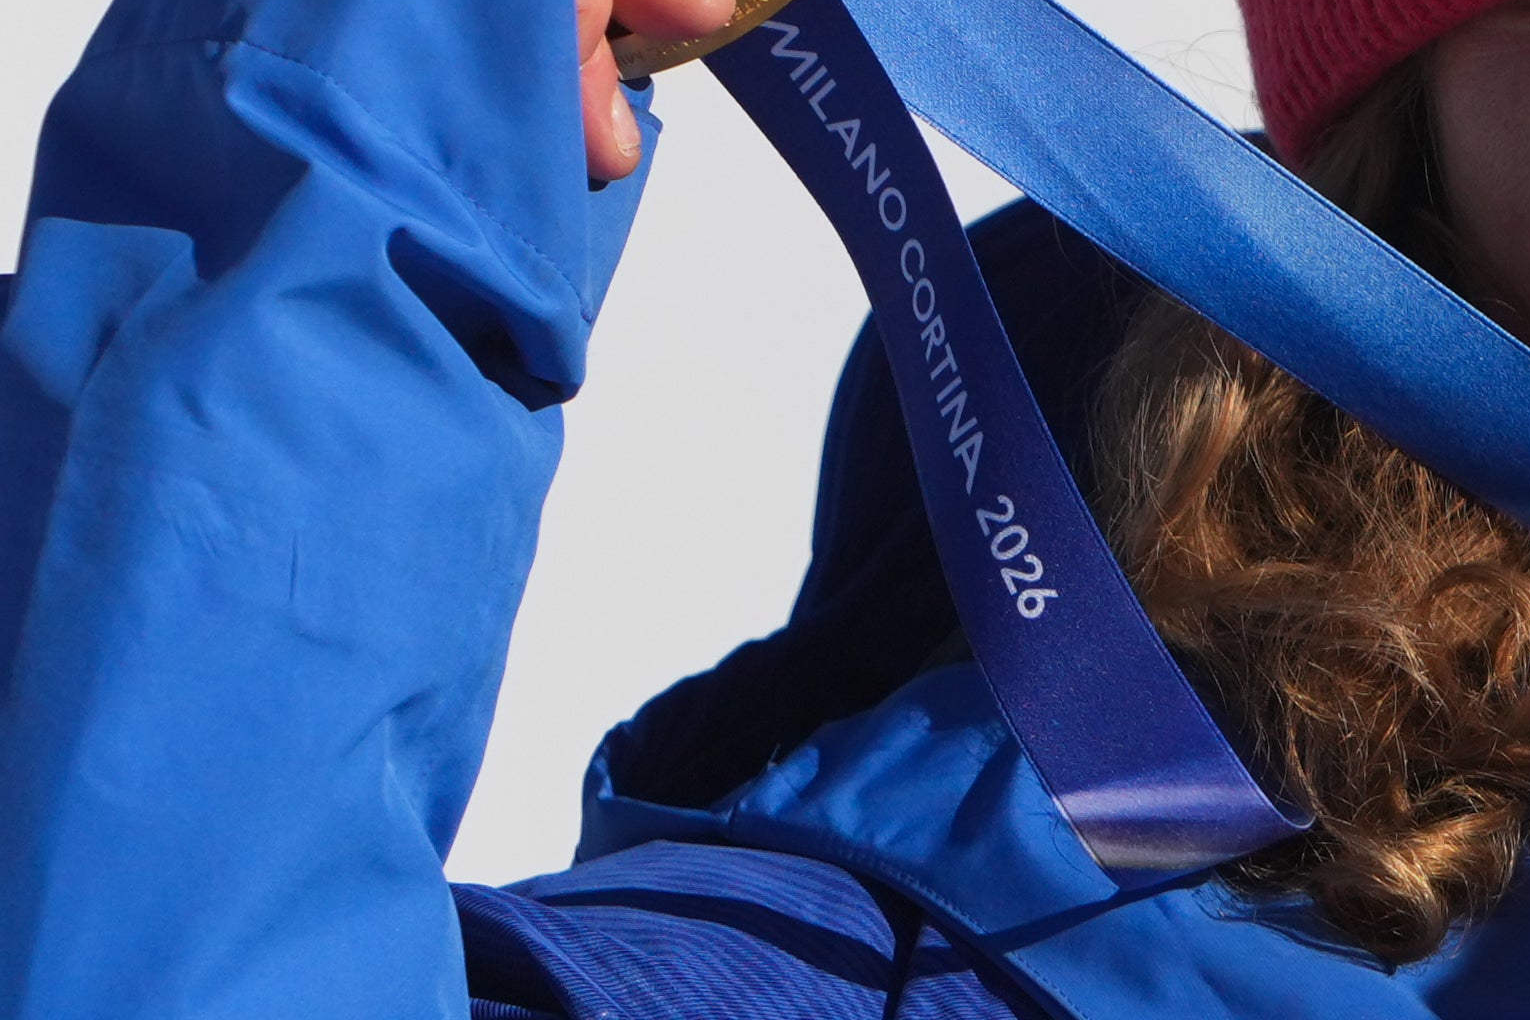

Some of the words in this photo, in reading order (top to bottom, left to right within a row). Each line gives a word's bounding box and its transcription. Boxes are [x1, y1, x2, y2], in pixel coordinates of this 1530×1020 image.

[761, 20, 907, 231] MILANO
[900, 238, 983, 495] CORTINA
[976, 495, 1058, 619] 2026
